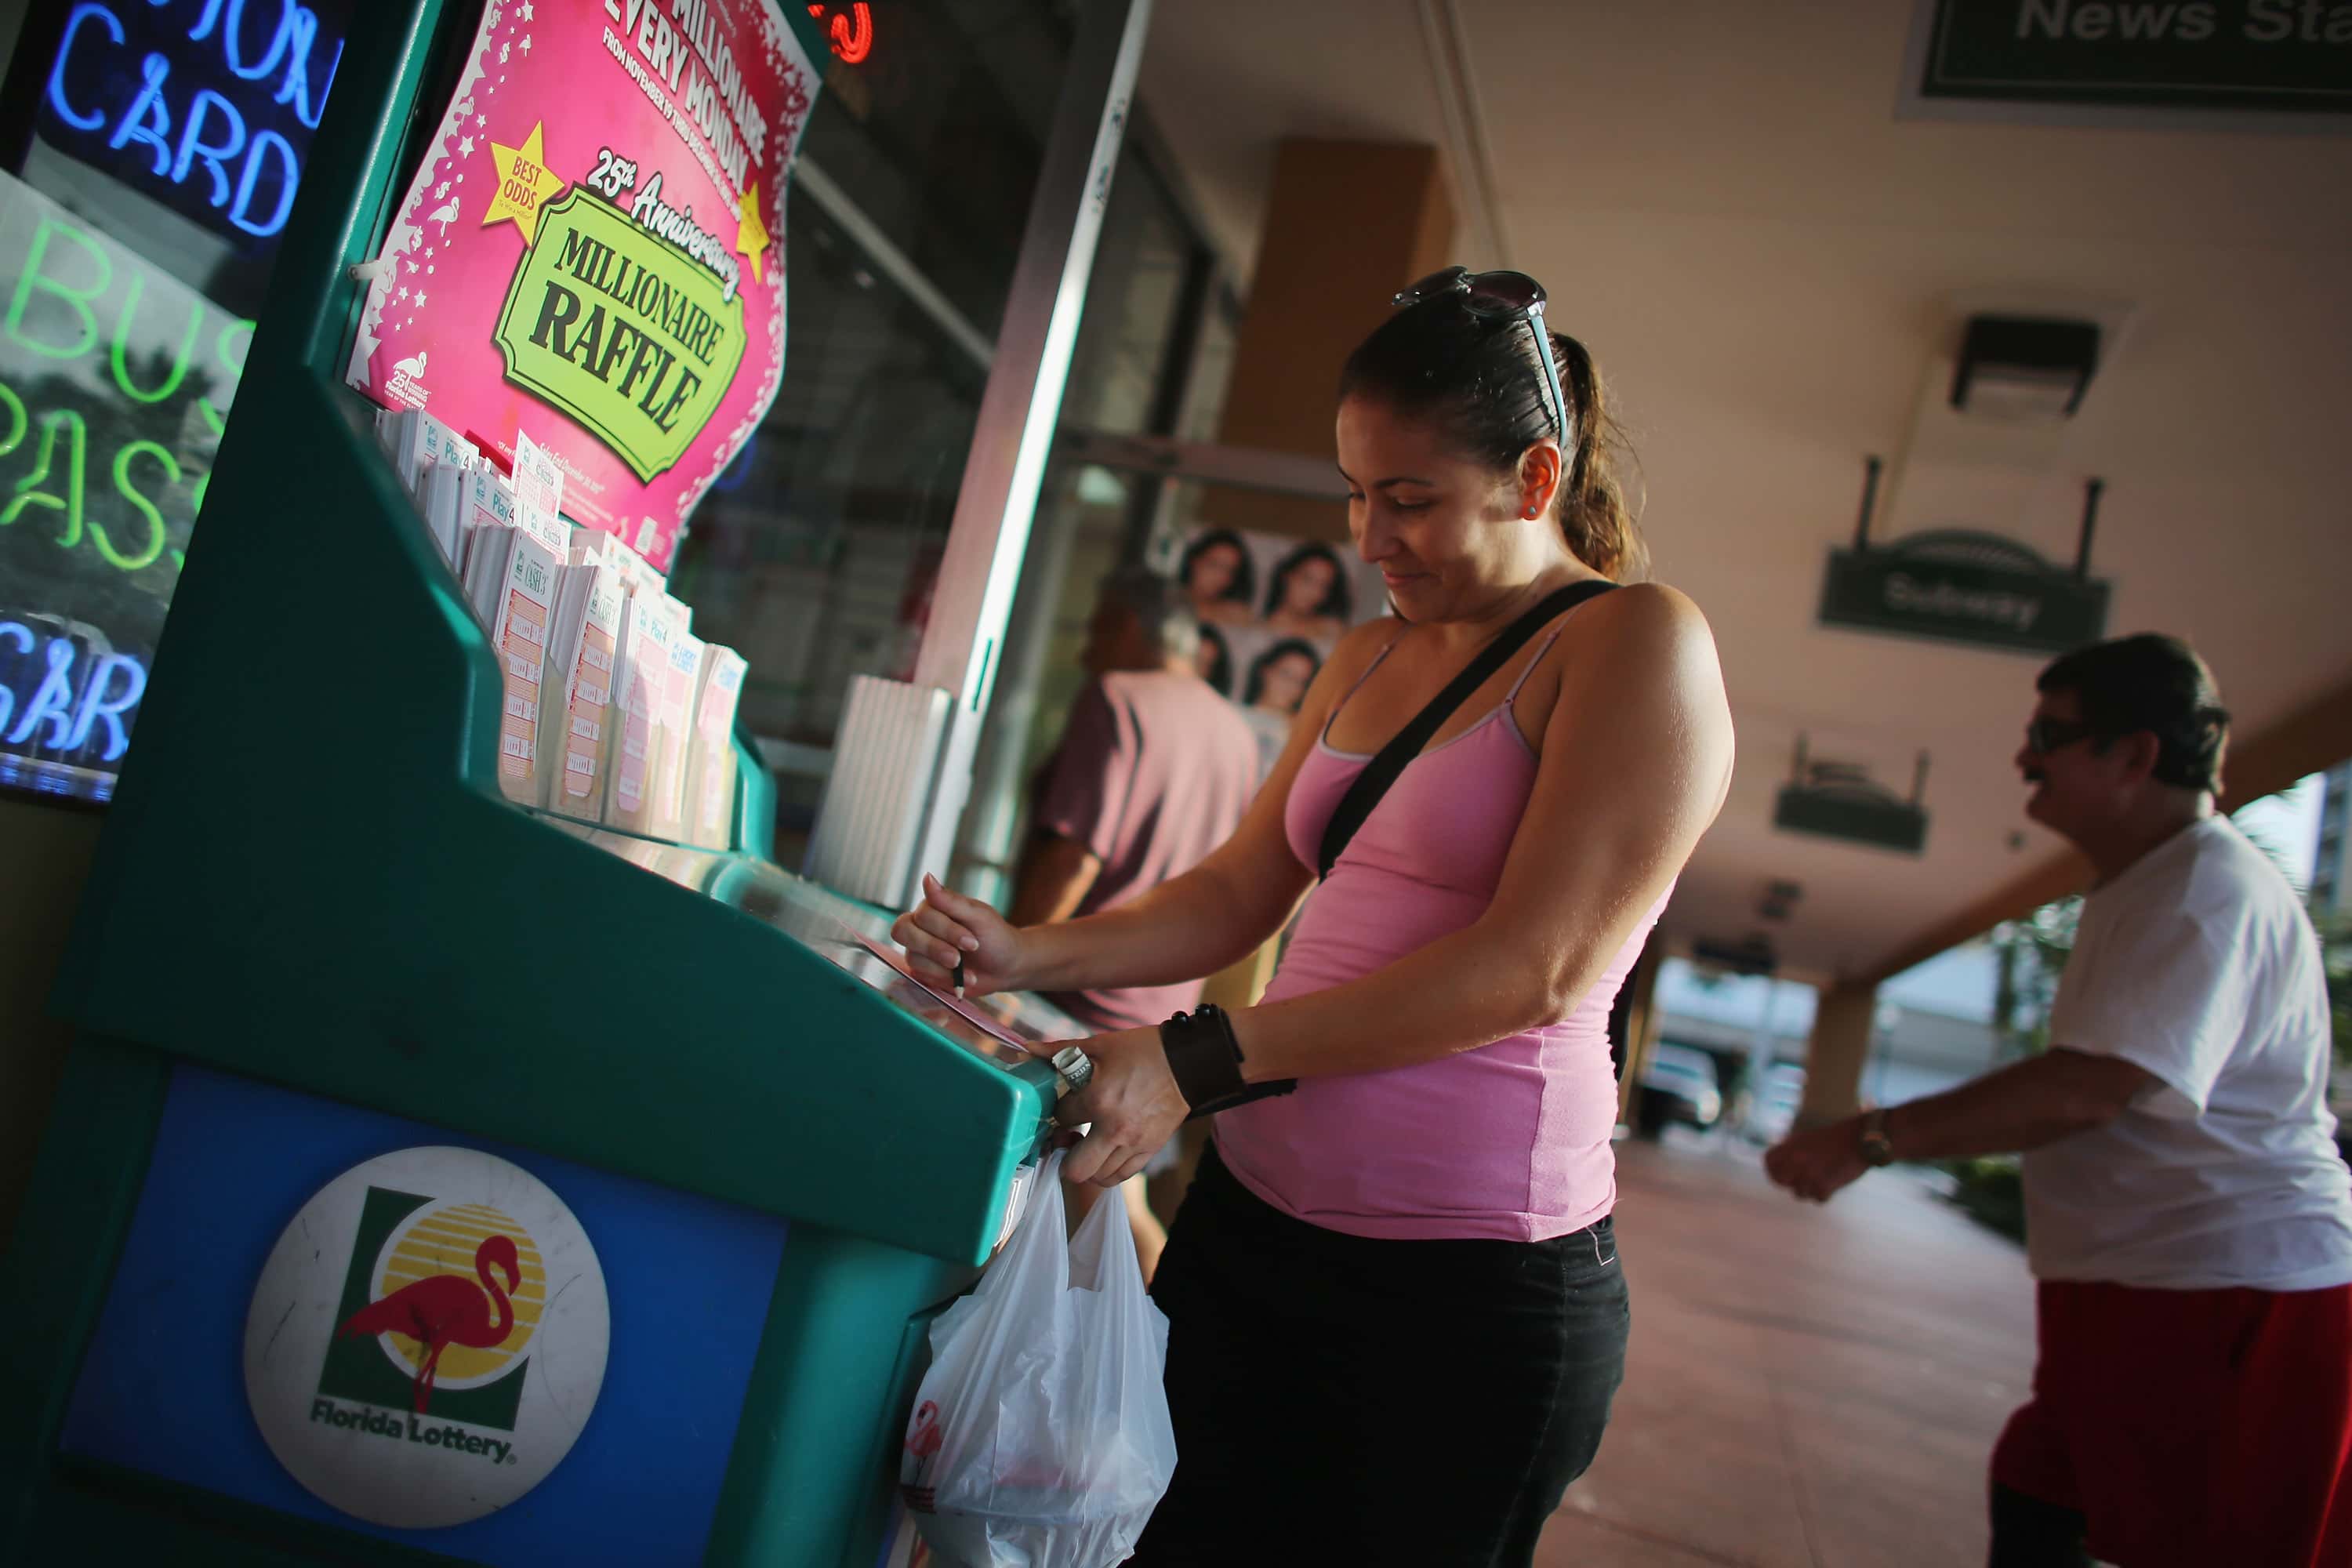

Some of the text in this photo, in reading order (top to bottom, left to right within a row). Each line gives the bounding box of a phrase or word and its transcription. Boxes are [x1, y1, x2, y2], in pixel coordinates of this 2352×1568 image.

[2015, 0, 2217, 41] News
[602, 26, 627, 68] FROM
[625, 53, 666, 112] NOVEMBER
[49, 3, 298, 235] CARD
[684, 59, 749, 197] MONDAY
[503, 178, 538, 211] ODDS
[512, 156, 543, 186] BEST
[587, 147, 638, 198] 25th
[630, 172, 740, 303] Anniversary
[554, 227, 724, 367] MILLIONAIRE
[391, 370, 407, 388] 25
[528, 280, 702, 434] RAFFLE
[445, 441, 470, 470] Play 4
[492, 493, 509, 522] Play
[508, 507, 515, 524] 4
[525, 564, 542, 593] CASH
[310, 1398, 512, 1465] Florida Lottery
